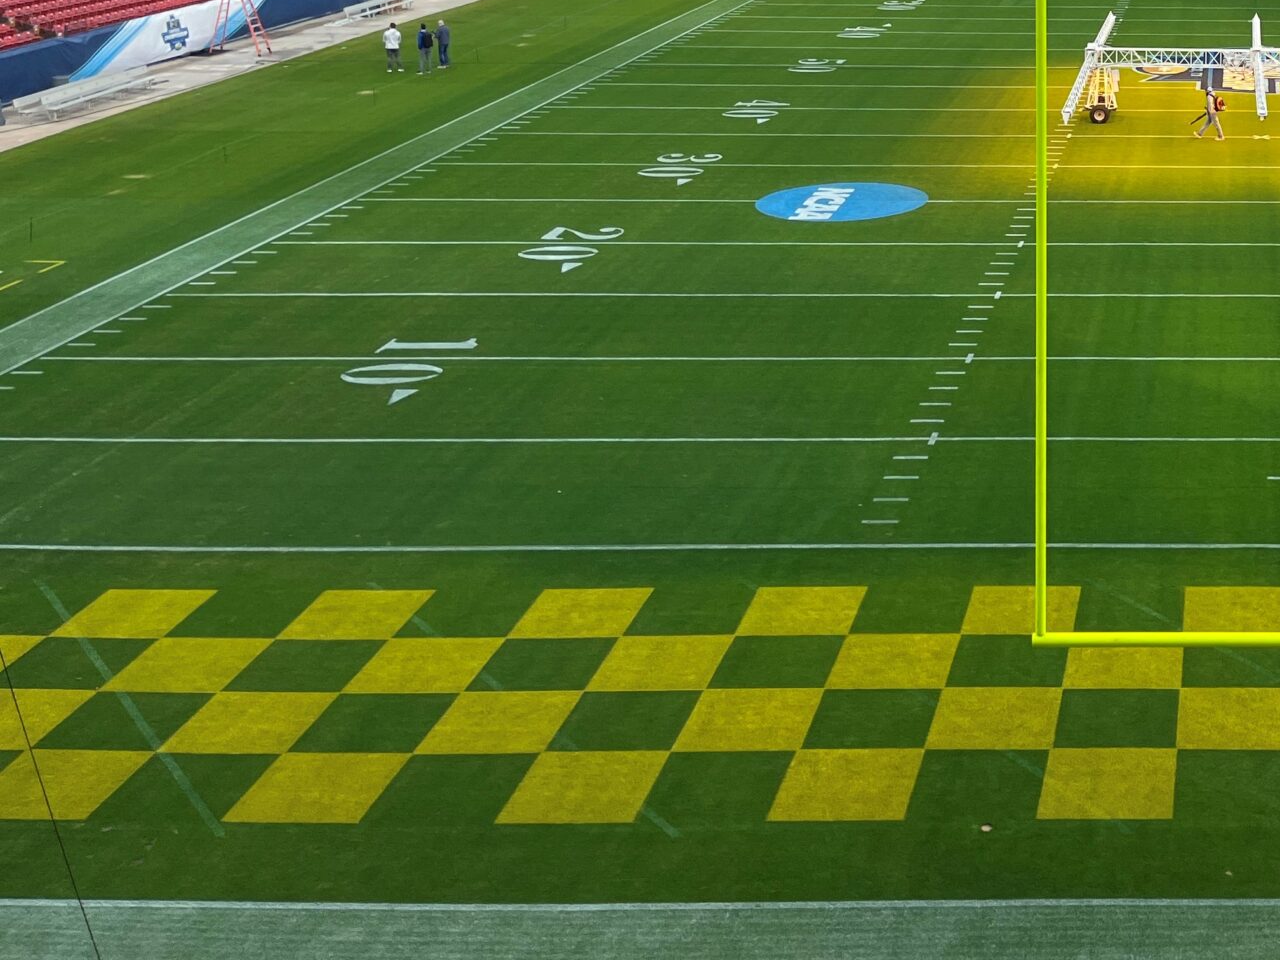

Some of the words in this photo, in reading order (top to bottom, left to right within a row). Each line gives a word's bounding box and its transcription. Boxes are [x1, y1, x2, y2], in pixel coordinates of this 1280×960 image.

[788, 58, 847, 73] 50
[722, 100, 790, 119] 40
[637, 153, 723, 177] 30
[788, 187, 855, 221] NCAA
[518, 226, 625, 261] 20
[340, 338, 478, 385] 10
